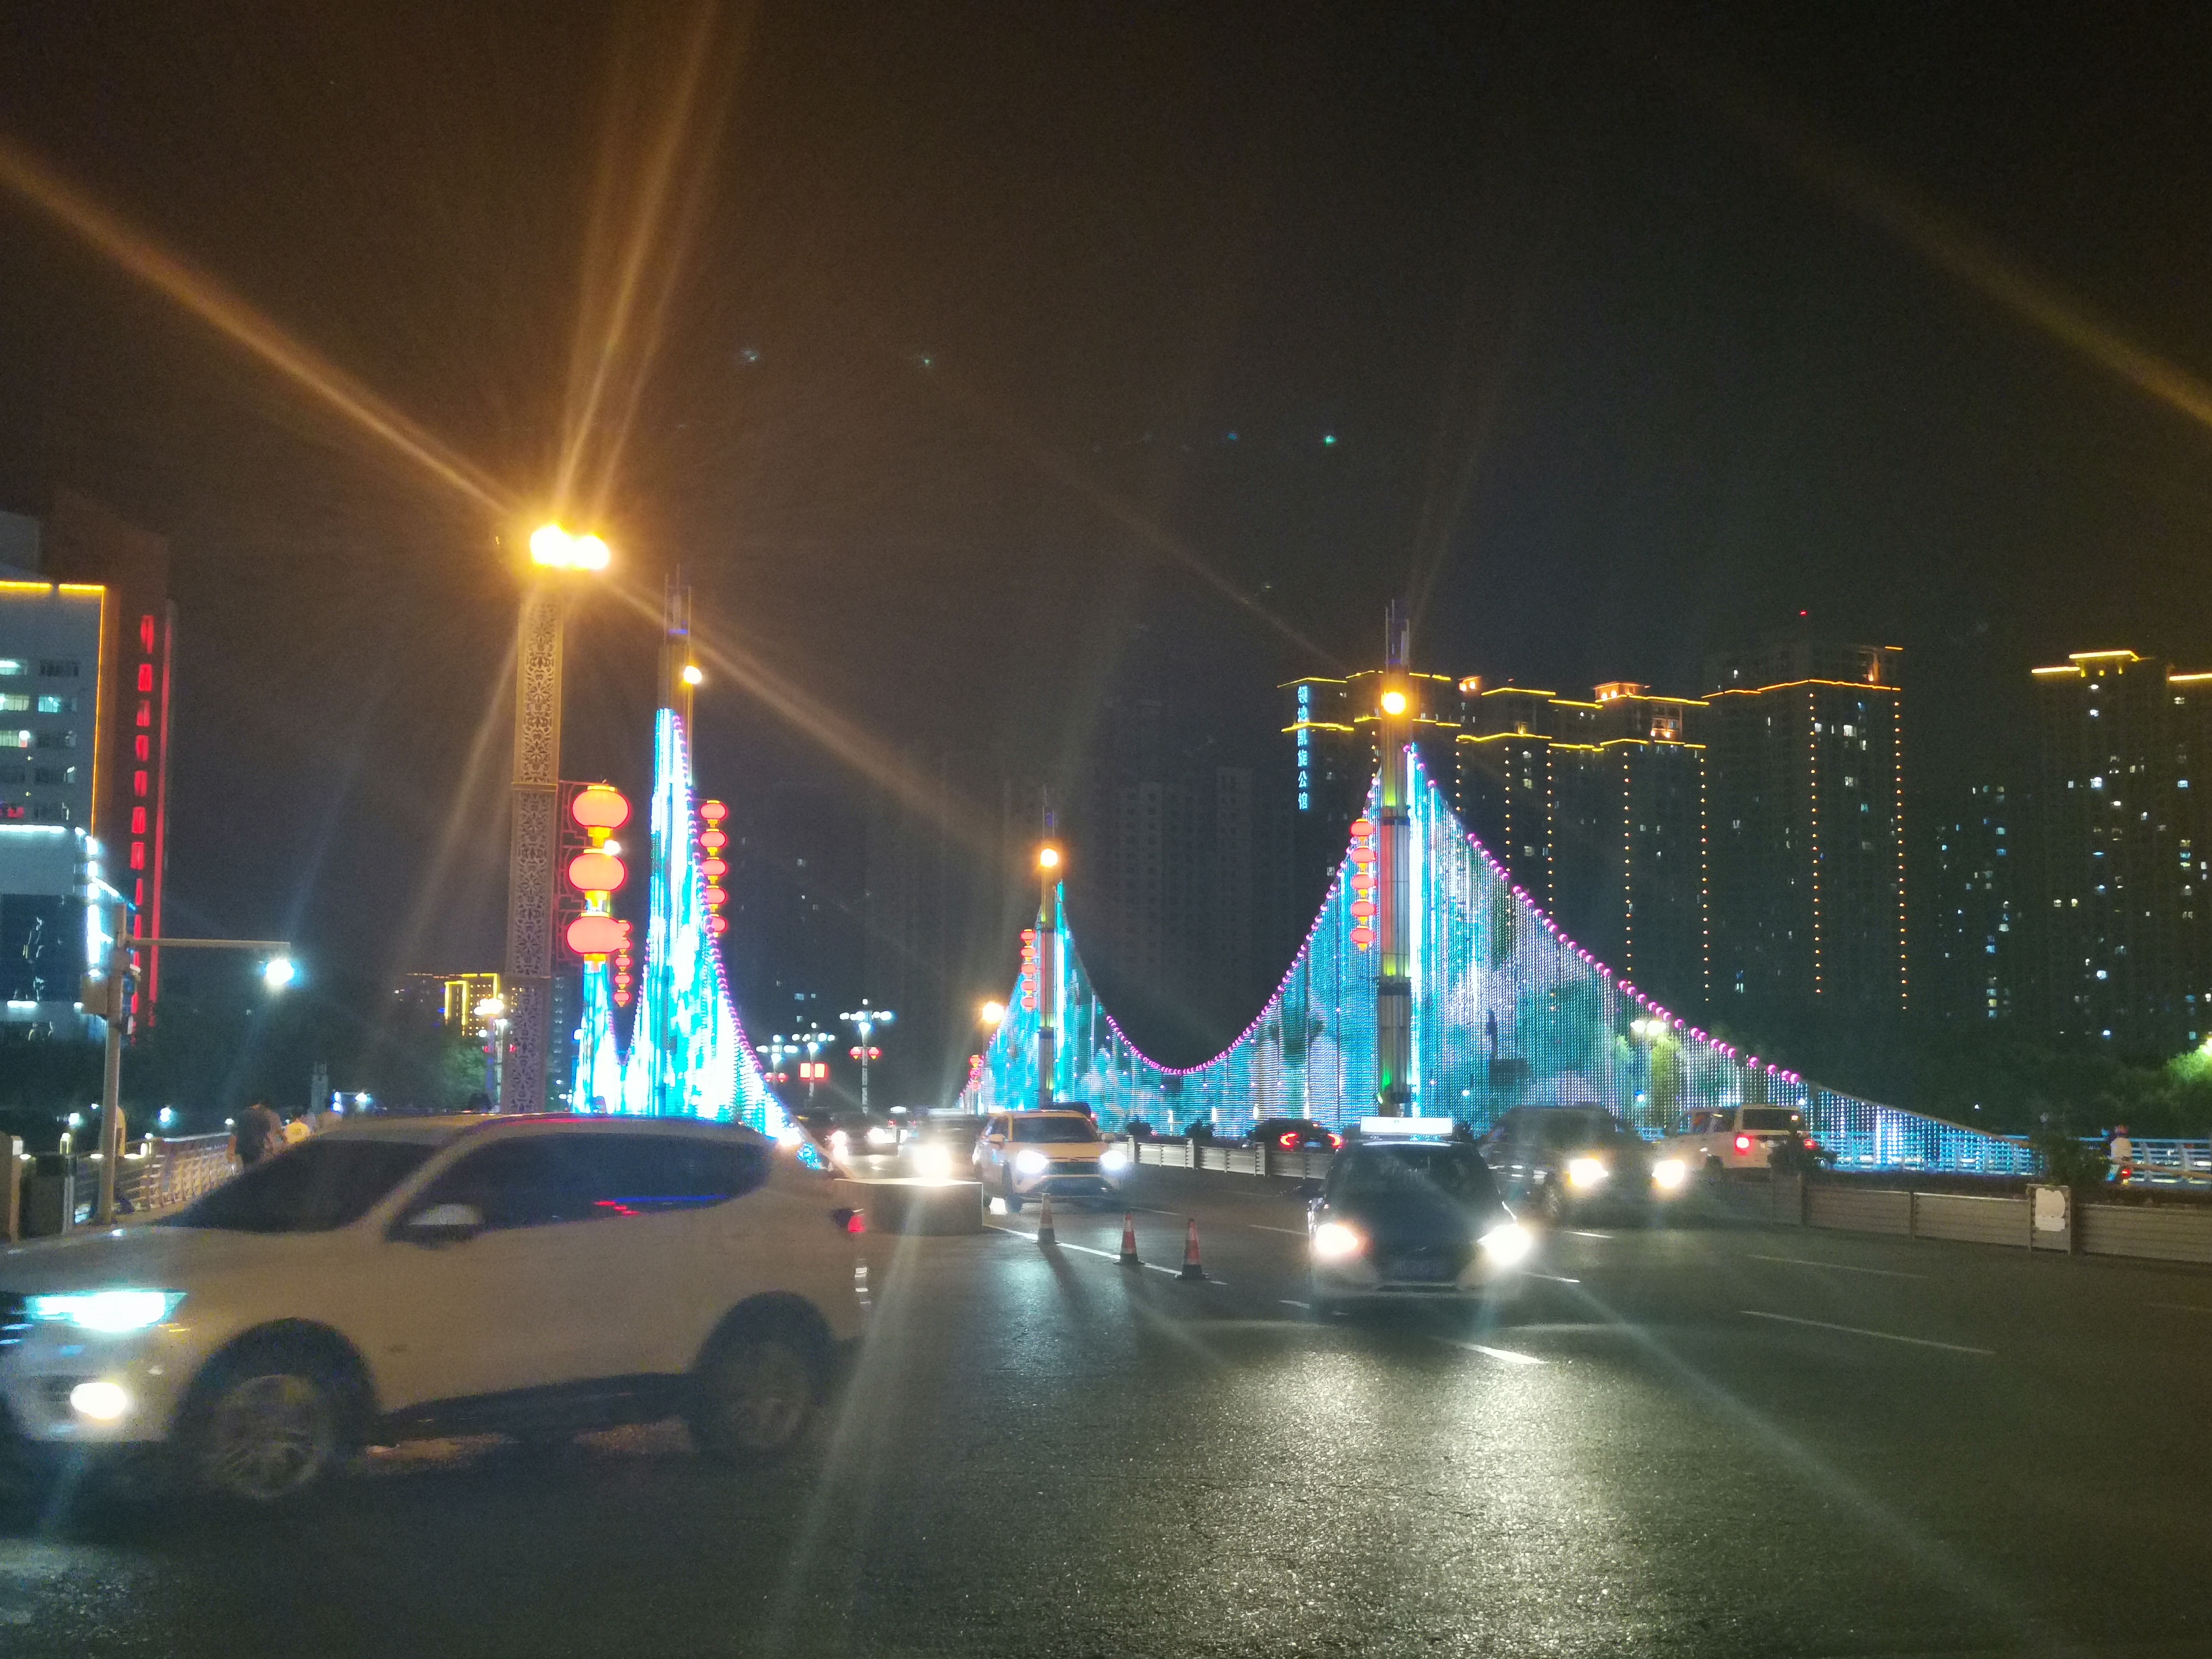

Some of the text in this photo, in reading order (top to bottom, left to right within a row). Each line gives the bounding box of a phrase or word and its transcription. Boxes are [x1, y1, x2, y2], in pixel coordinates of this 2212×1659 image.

[1297, 686, 1308, 810] 领地凯旋公馆
